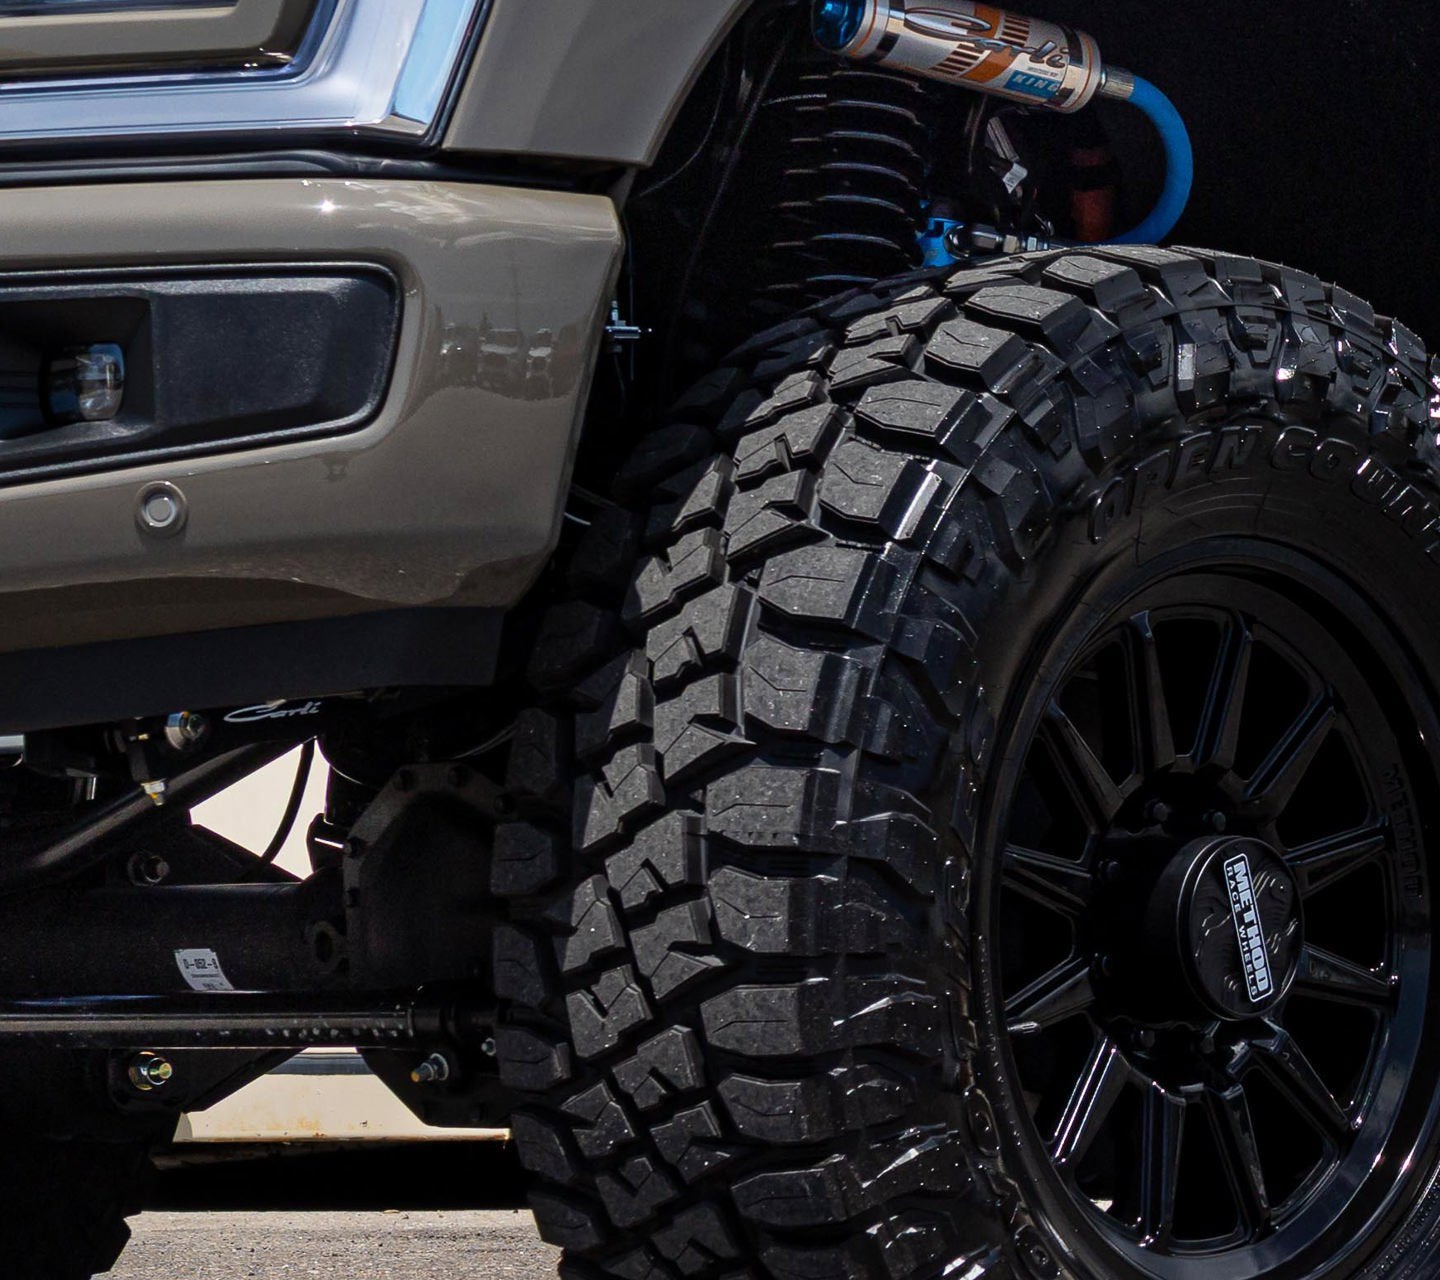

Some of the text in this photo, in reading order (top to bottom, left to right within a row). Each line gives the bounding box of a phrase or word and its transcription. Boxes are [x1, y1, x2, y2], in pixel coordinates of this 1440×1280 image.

[1012, 73, 1061, 93] KING
[1087, 424, 1263, 545] OPEN
[1226, 866, 1258, 996] RACE WHEELS
[1233, 860, 1269, 992] METHOD
